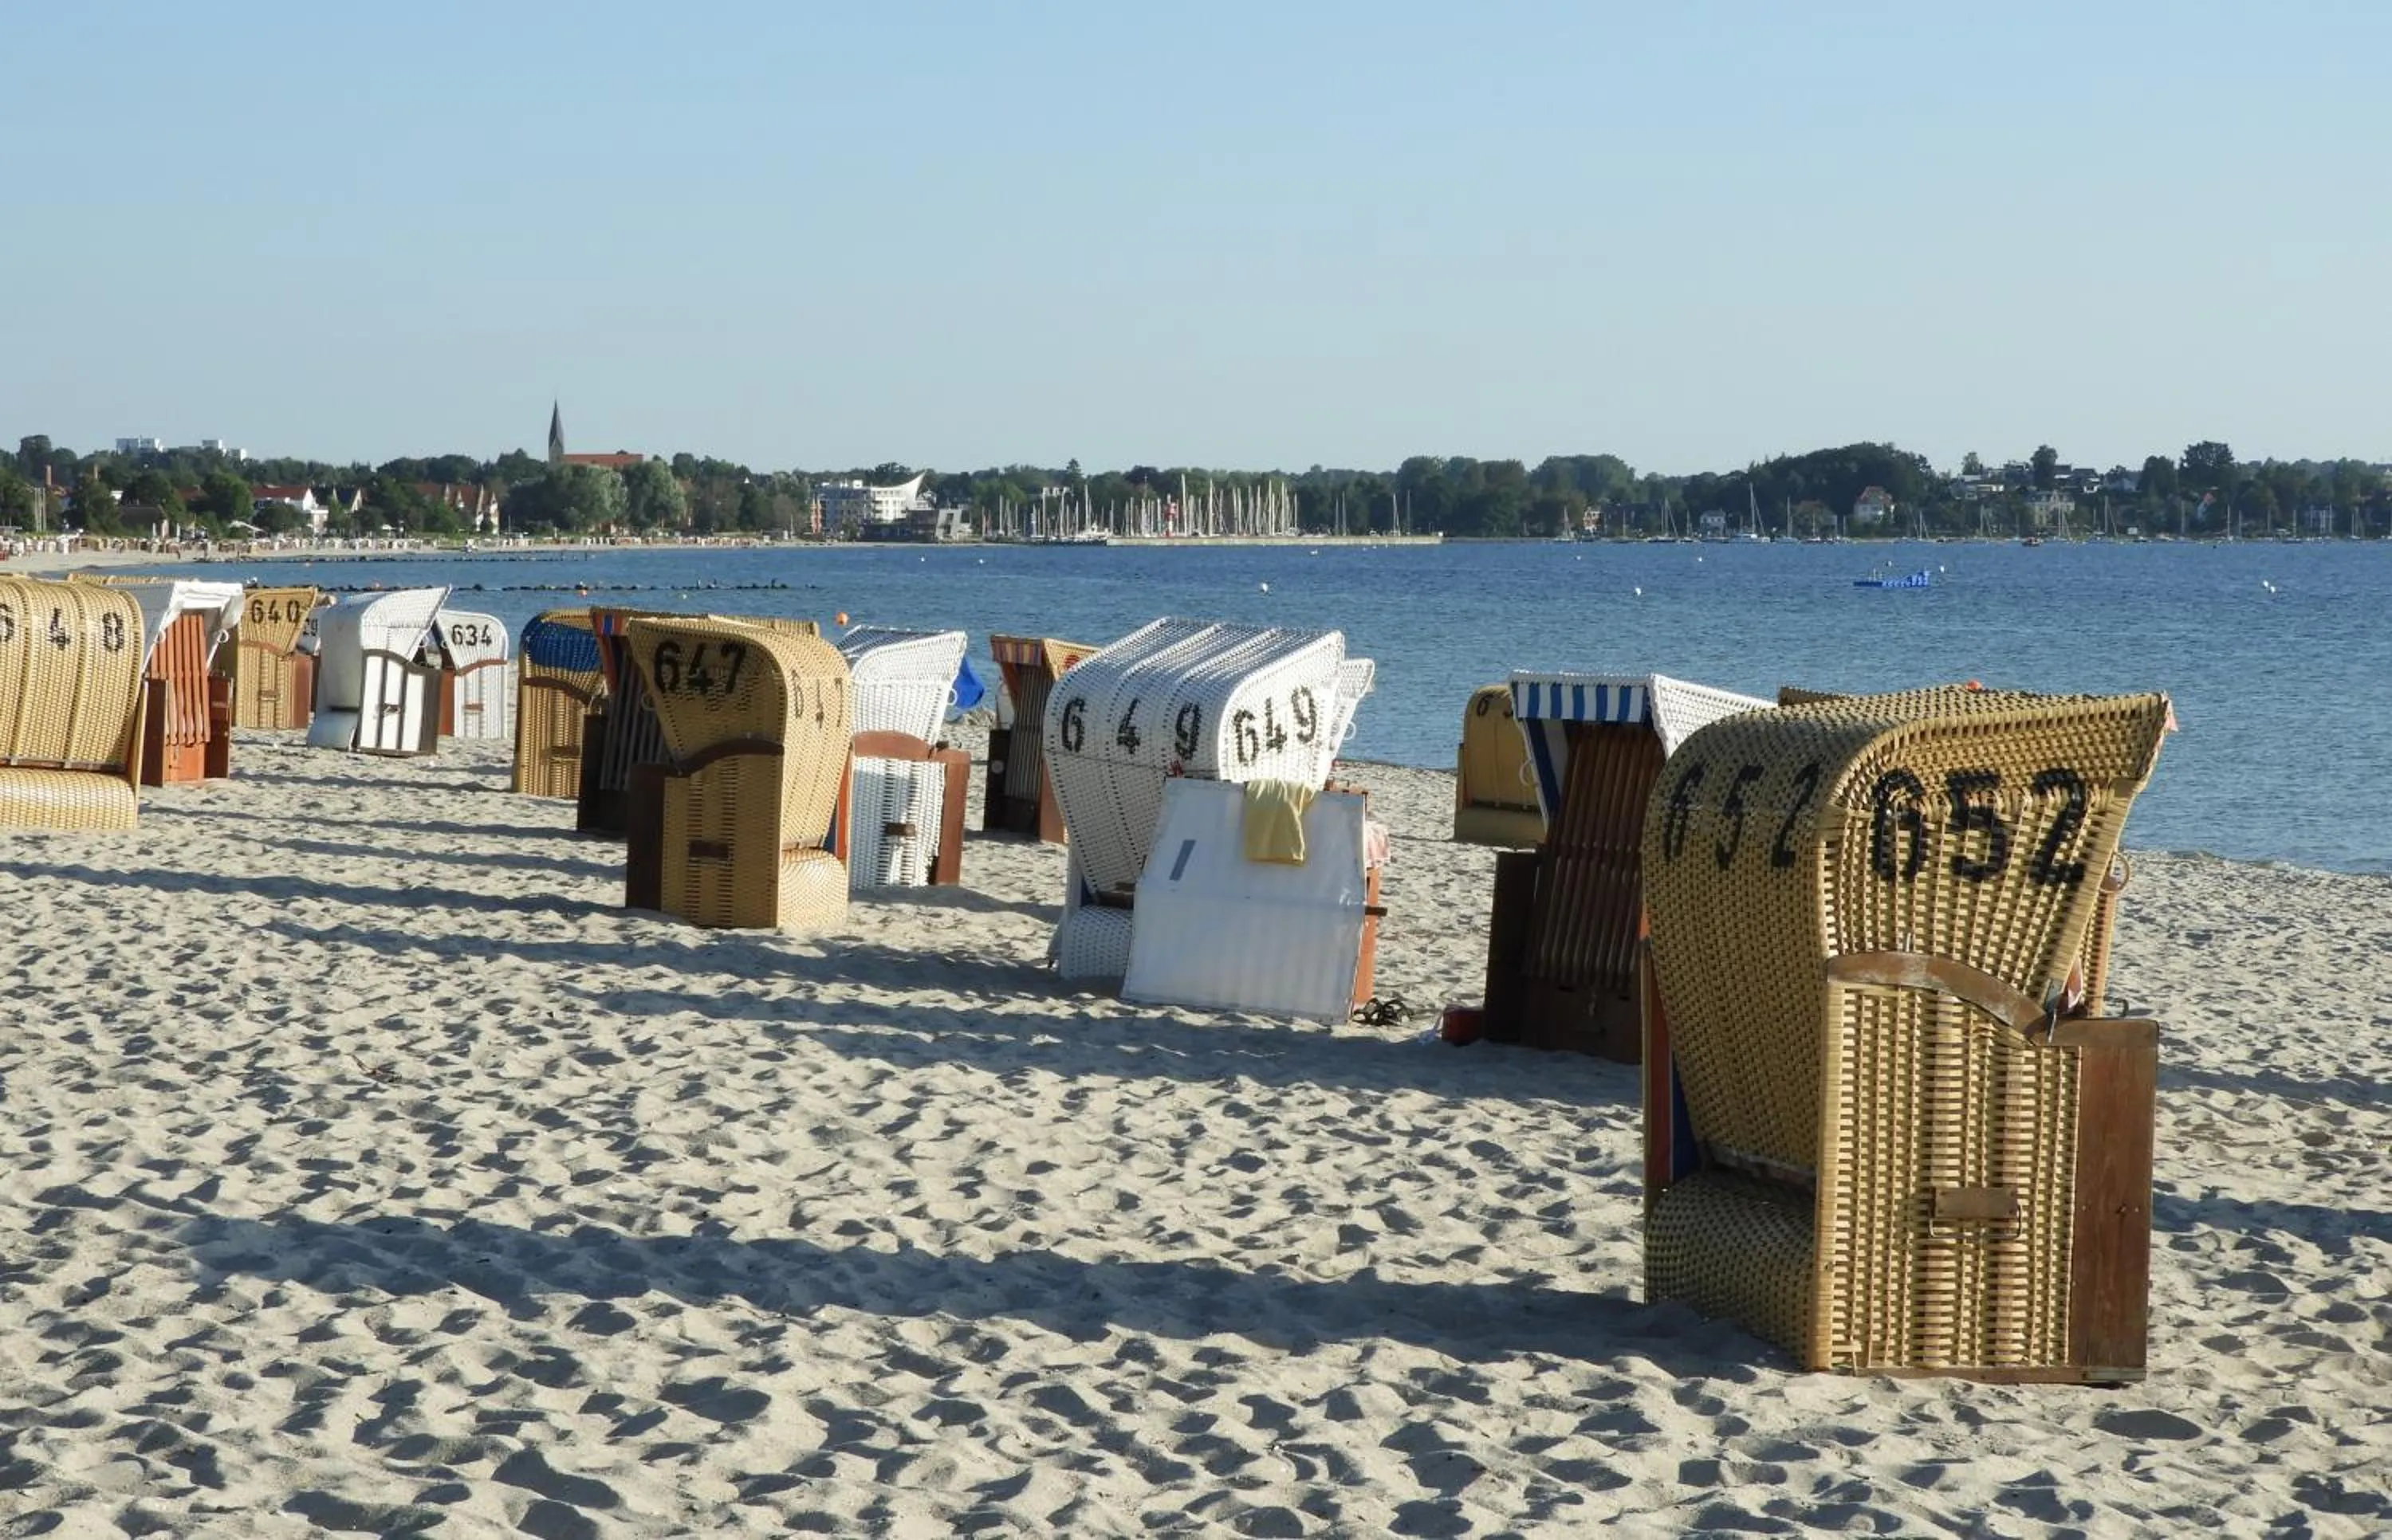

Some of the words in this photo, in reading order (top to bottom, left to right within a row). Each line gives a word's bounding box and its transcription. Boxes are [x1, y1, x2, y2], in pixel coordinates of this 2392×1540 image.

[252, 599, 300, 623] 640
[451, 624, 492, 646] 634
[654, 640, 746, 694] 647
[1233, 686, 1317, 765] 649
[1873, 767, 2087, 883] 652
